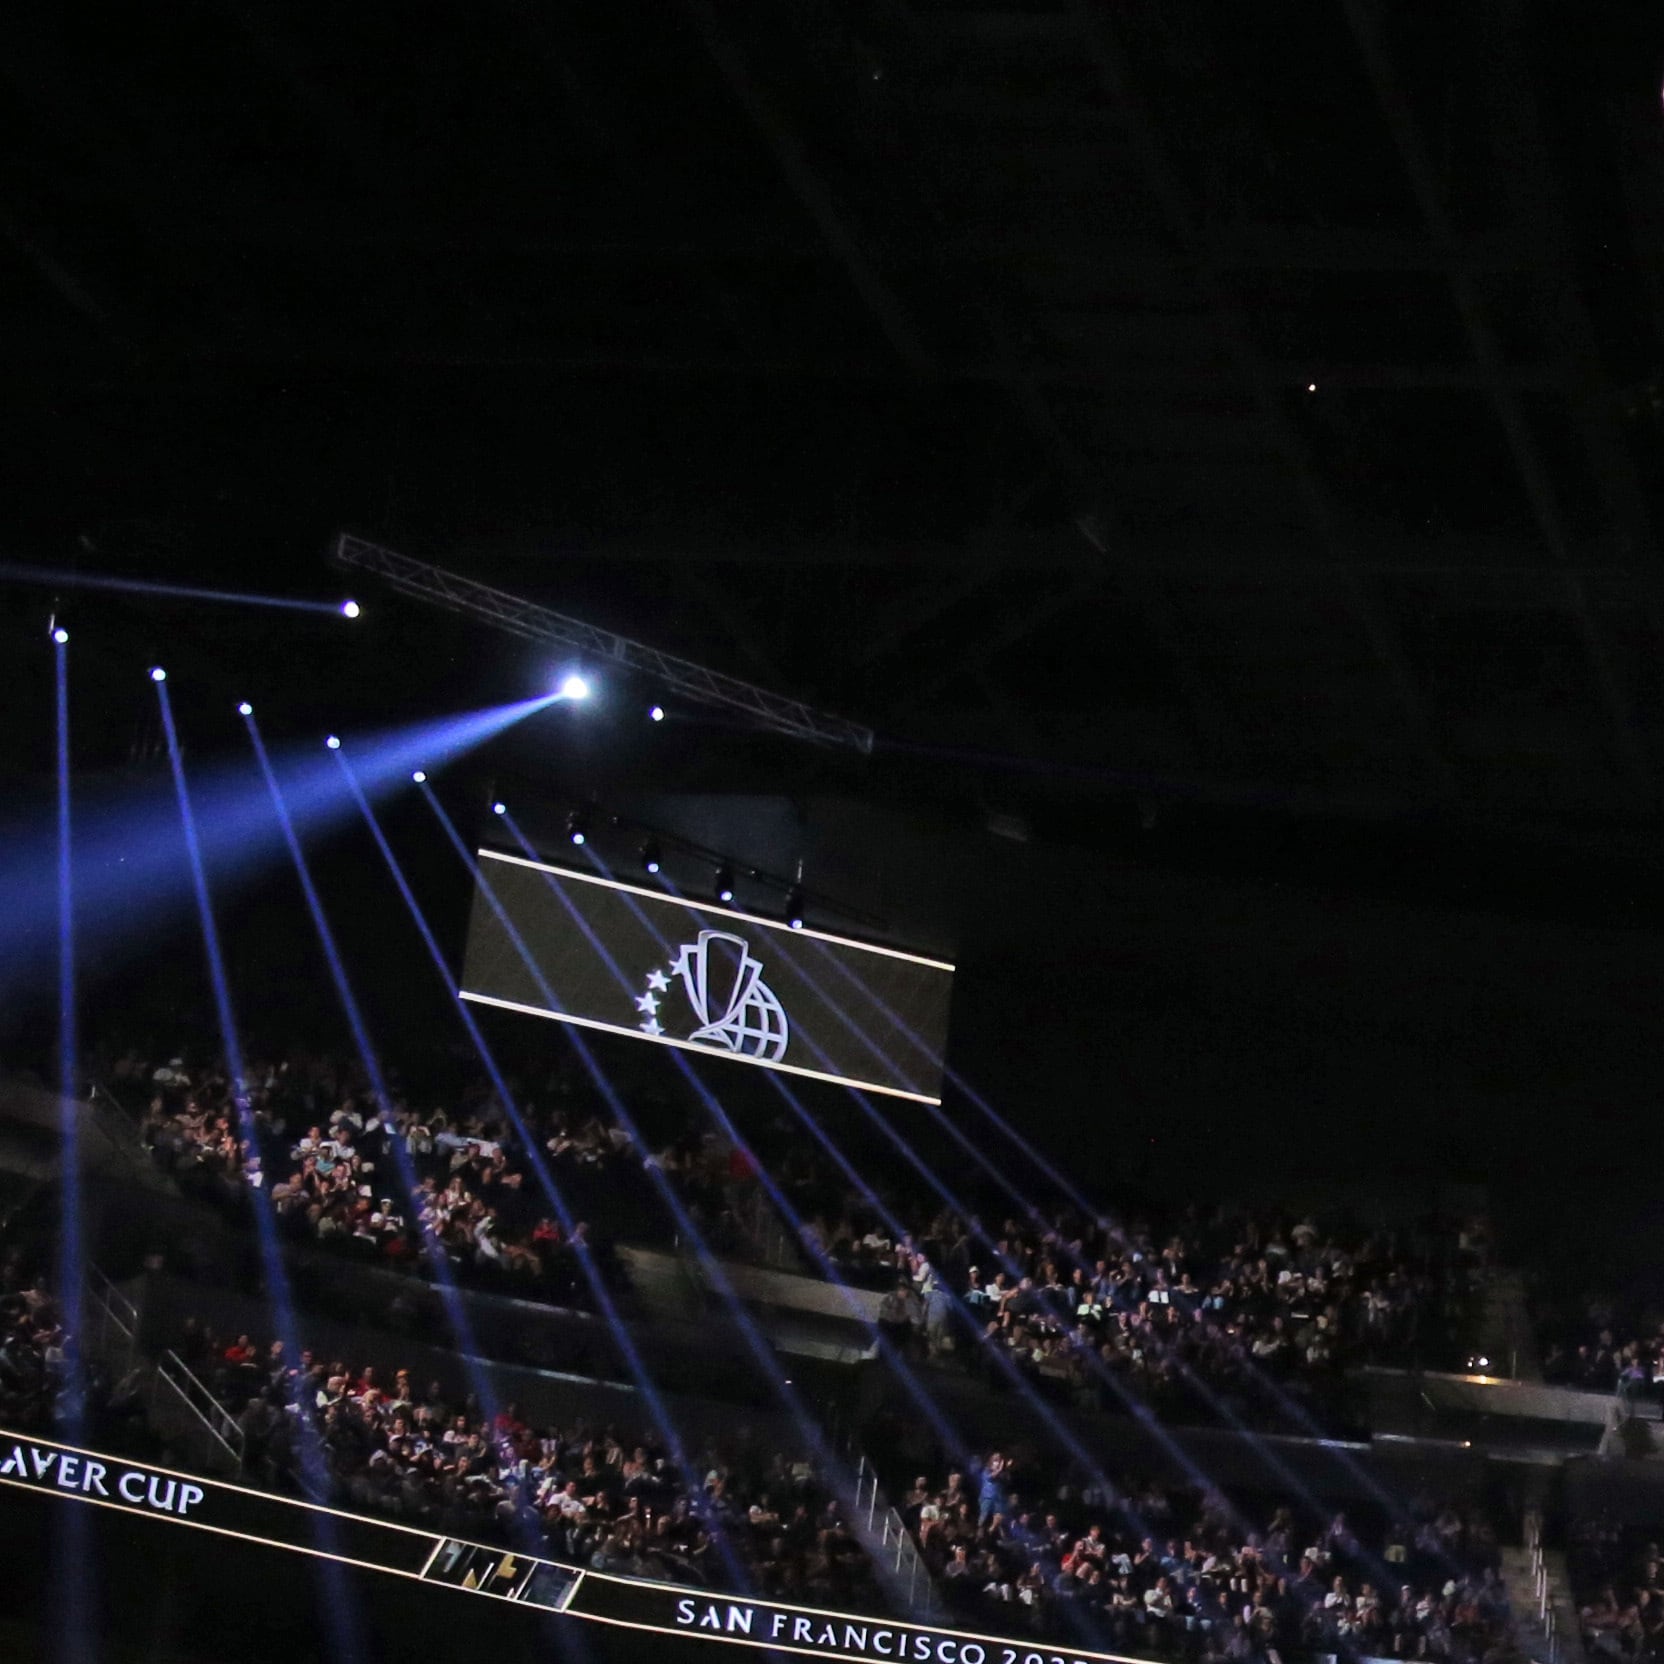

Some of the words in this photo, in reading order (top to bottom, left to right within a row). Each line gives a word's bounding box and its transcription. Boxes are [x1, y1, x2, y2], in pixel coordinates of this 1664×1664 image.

[0, 1445, 110, 1497] AVER
[118, 1471, 204, 1514] CUP
[676, 1599, 754, 1634] SAN
